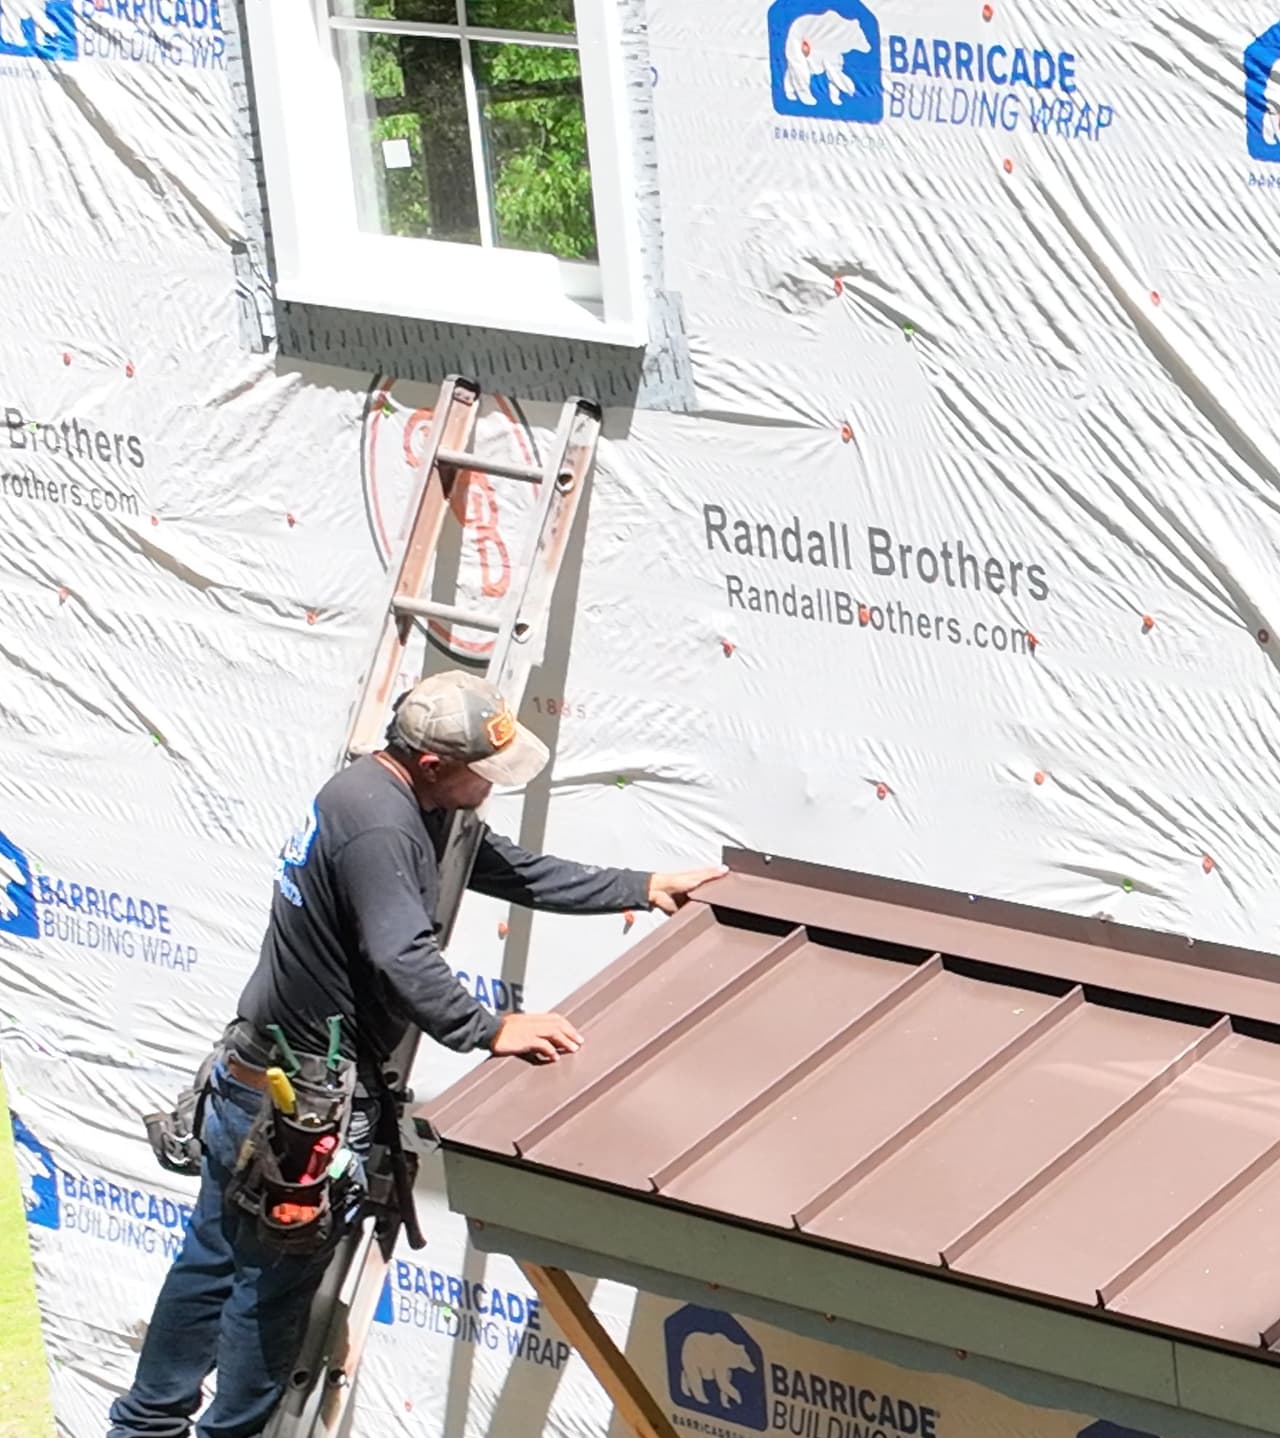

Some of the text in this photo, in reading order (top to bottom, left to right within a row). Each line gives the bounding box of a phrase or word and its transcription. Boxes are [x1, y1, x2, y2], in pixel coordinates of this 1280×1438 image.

[889, 35, 1077, 92] BARRICADE
[890, 82, 1113, 141] BUILDING WRAP
[4, 407, 145, 468] Brothers
[703, 503, 1050, 601] Randall Brothers
[726, 574, 1035, 656] RandallBrothers.com
[38, 875, 172, 935] BARRICADE
[44, 909, 198, 973] BUILDING WRAP
[64, 1202, 156, 1254] BUILDING
[396, 1258, 542, 1331] BARRICADE
[399, 1295, 571, 1370] BUILDING WRAP
